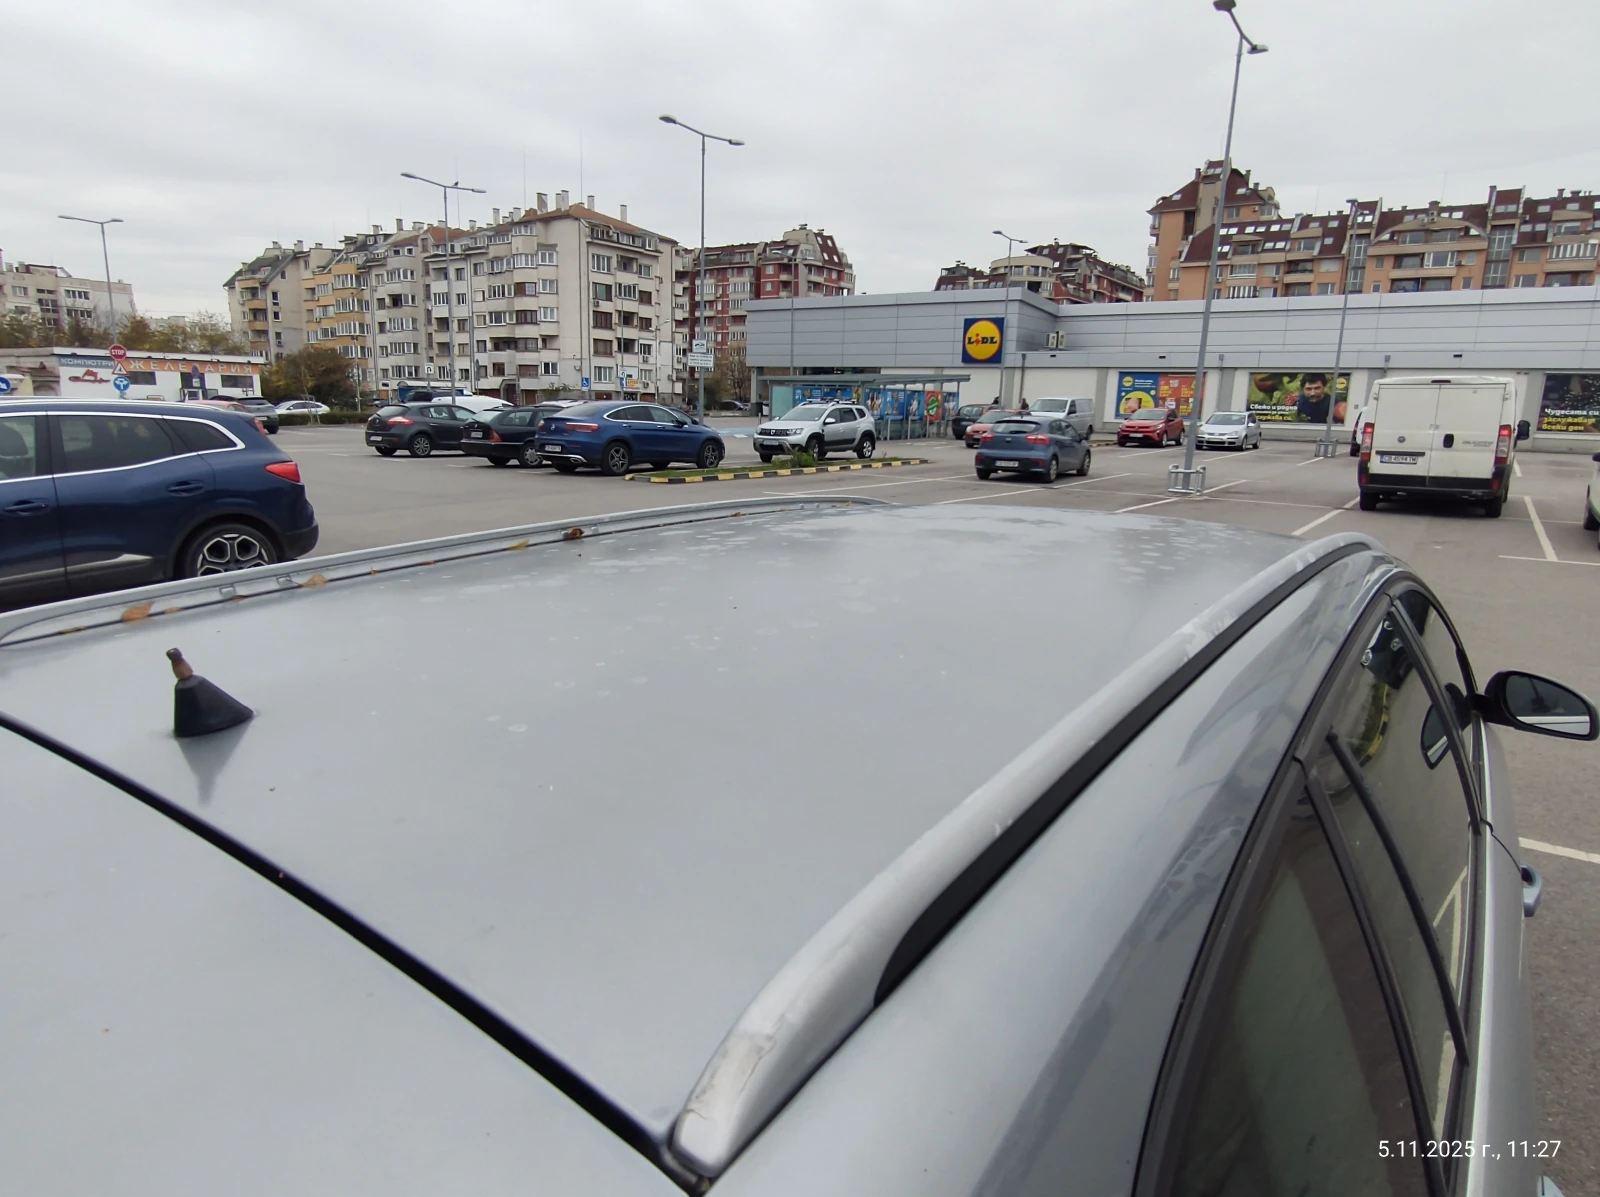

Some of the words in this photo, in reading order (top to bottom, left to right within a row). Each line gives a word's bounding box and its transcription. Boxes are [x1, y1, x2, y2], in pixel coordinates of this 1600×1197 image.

[967, 333, 998, 346] LIDL
[129, 360, 252, 373] ЖЕЛЕАРИЯ
[1544, 408, 1587, 416] Чудесата
